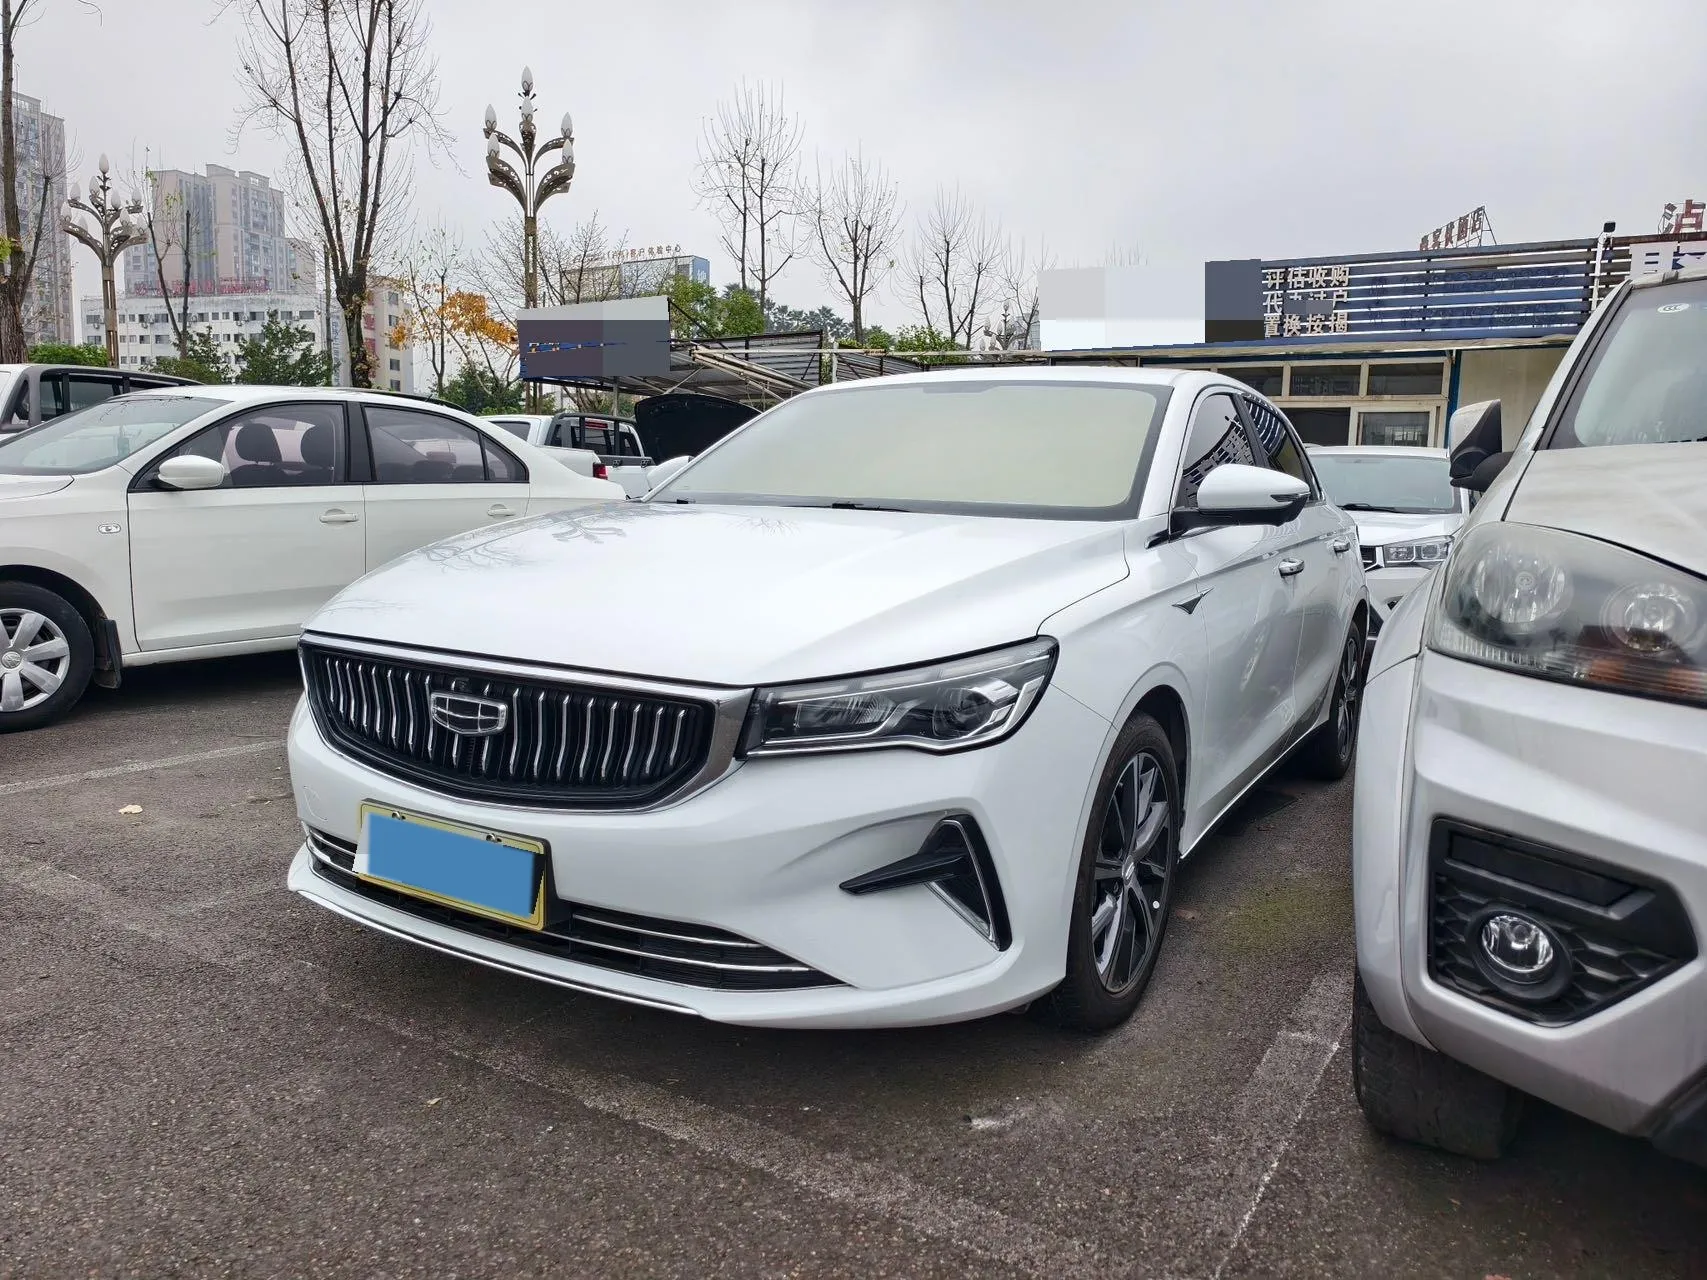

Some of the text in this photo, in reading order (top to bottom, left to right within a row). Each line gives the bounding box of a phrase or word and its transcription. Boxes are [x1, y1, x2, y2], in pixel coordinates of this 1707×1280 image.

[1265, 265, 1349, 289] 评估收购
[1264, 312, 1348, 337] 置换按揭
